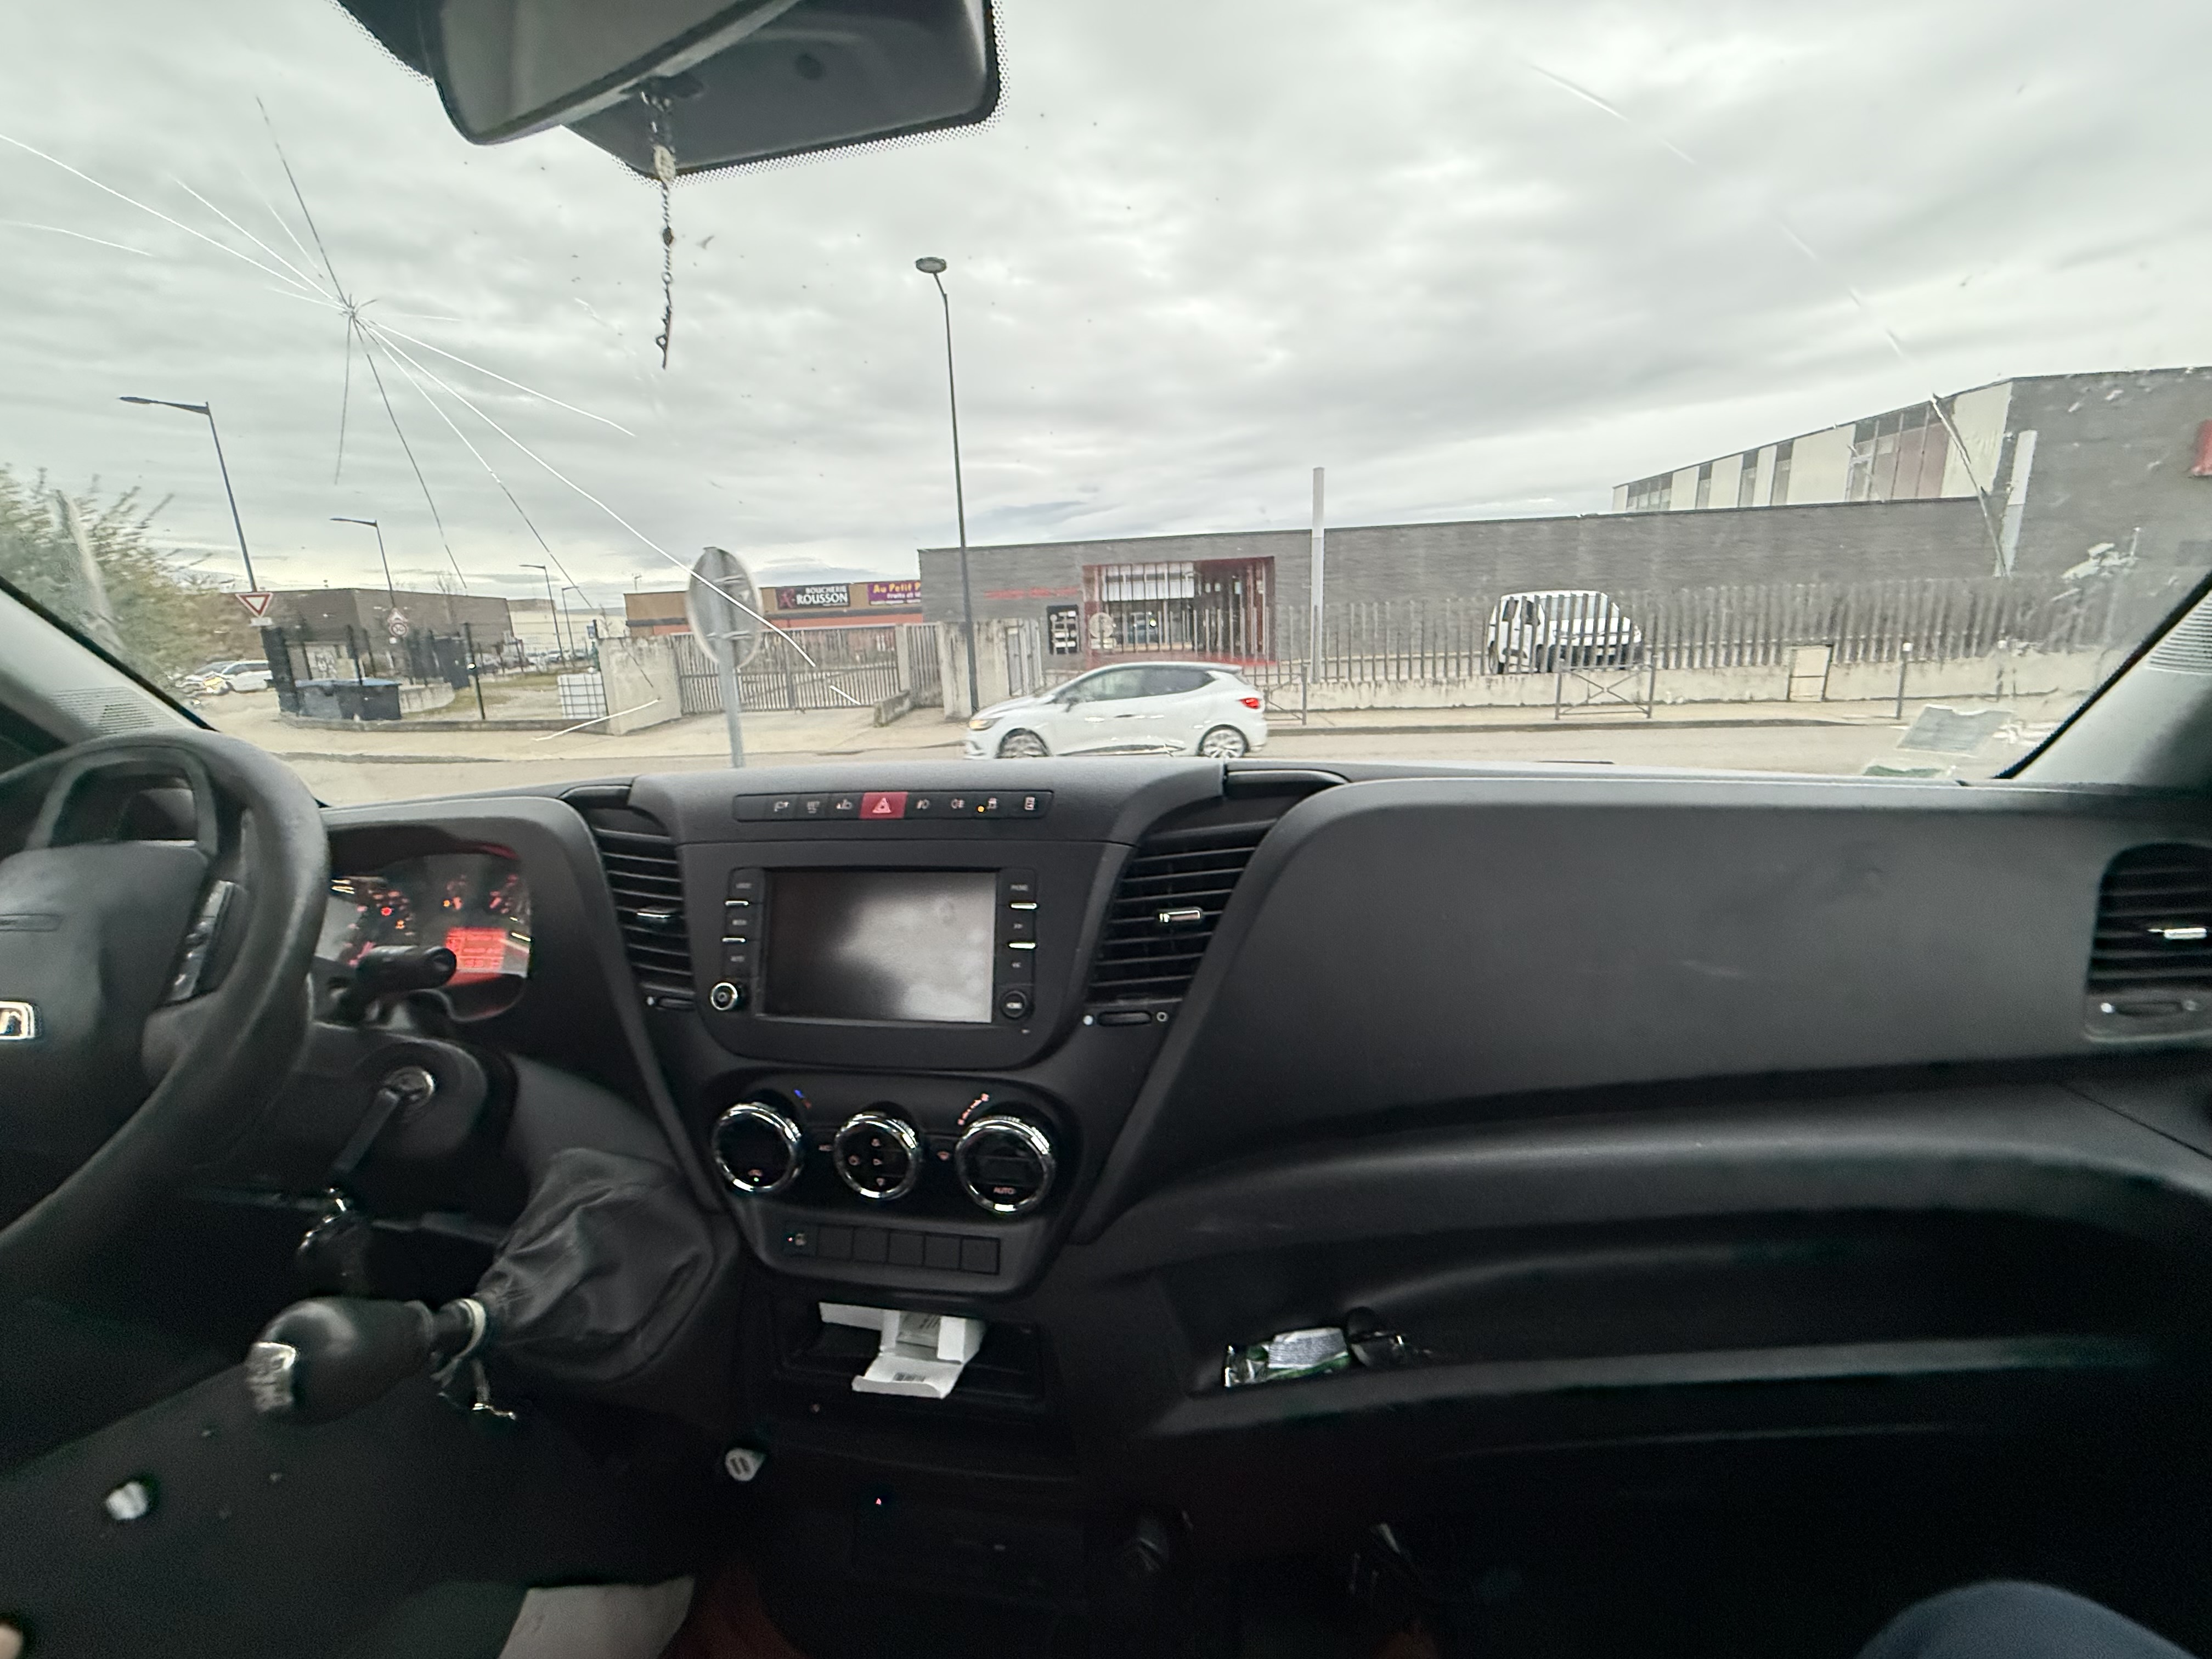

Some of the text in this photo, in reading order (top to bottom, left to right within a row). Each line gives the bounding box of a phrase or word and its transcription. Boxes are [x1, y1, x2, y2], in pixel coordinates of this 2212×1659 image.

[873, 584, 887, 594] Au
[889, 583, 912, 592] Petit
[796, 592, 848, 605] ROUSSON
